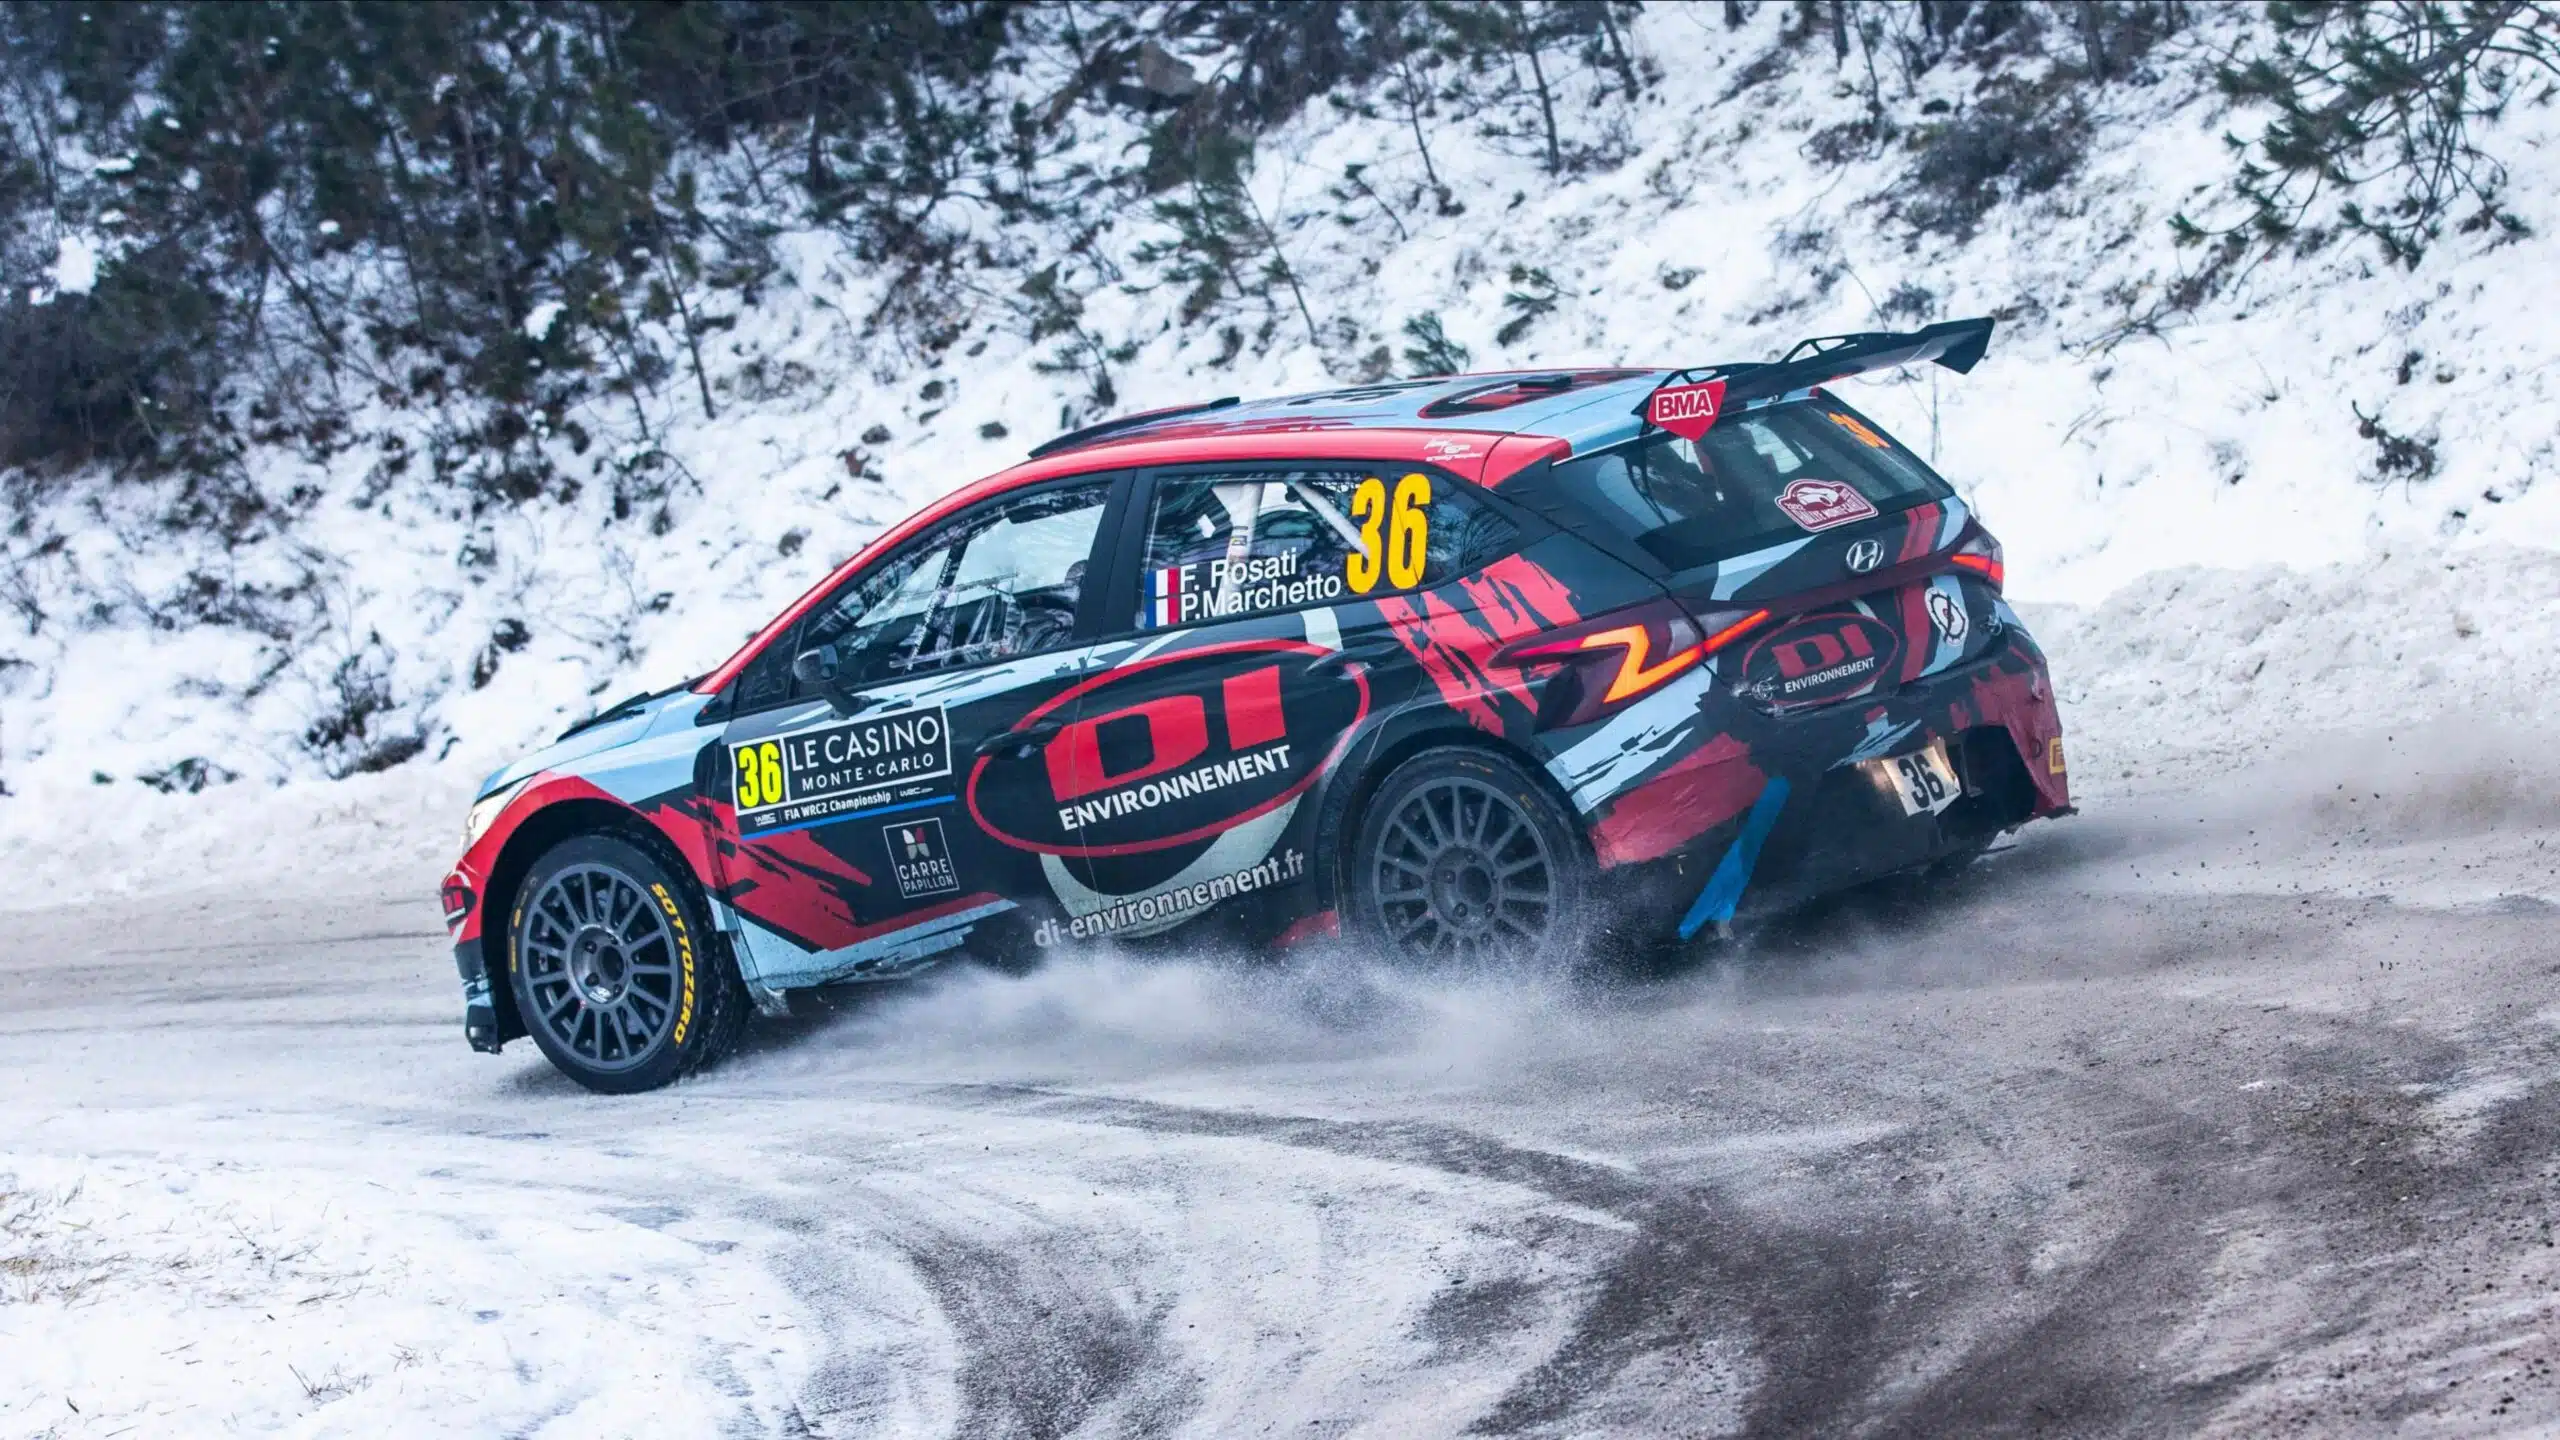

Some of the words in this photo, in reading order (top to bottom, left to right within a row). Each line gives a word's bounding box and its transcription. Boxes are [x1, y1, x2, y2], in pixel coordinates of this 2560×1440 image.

[1656, 389, 1714, 422] BMA
[1346, 472, 1431, 594] 36
[1179, 564, 1199, 594] F.
[1211, 546, 1297, 588] Rosati
[1180, 574, 1341, 622] P.Marchetto
[1772, 624, 1874, 678] DI
[1784, 656, 1876, 694] ENVIRONNEMENT
[790, 739, 819, 772] LE
[825, 715, 940, 764] CASINO
[1044, 664, 1287, 803] DI
[738, 741, 782, 808] 36
[1058, 744, 1291, 832] ENVIRONNEMENT
[1897, 753, 1946, 809] 36
[784, 808, 800, 822] FIA
[800, 803, 828, 817] WRC2
[829, 791, 892, 813] Championship
[899, 858, 950, 880] CARRE
[903, 875, 954, 893] PAPILLON
[1033, 848, 1305, 948] di-environnement.fr
[650, 882, 695, 1046] SOTTOZERO
